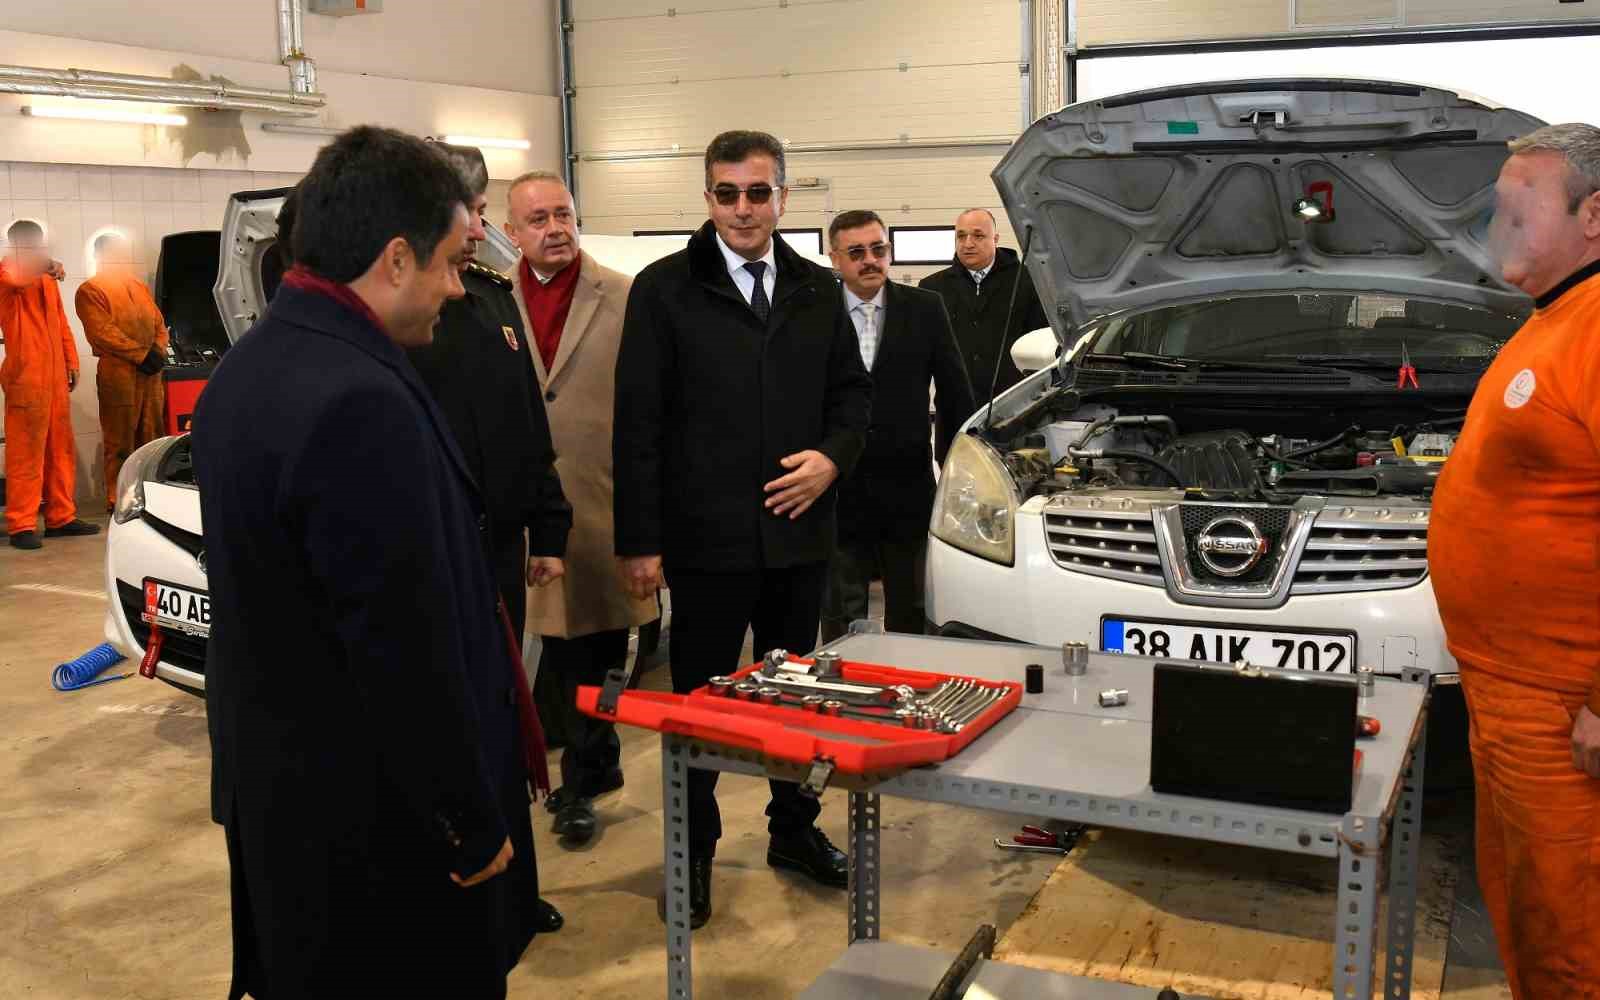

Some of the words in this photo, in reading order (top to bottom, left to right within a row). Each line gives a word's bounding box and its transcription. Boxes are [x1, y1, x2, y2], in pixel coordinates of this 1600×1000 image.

[1200, 539, 1257, 551] NISSAN
[157, 587, 182, 617] 40
[1125, 627, 1170, 658] 38
[1272, 638, 1347, 674] 702
